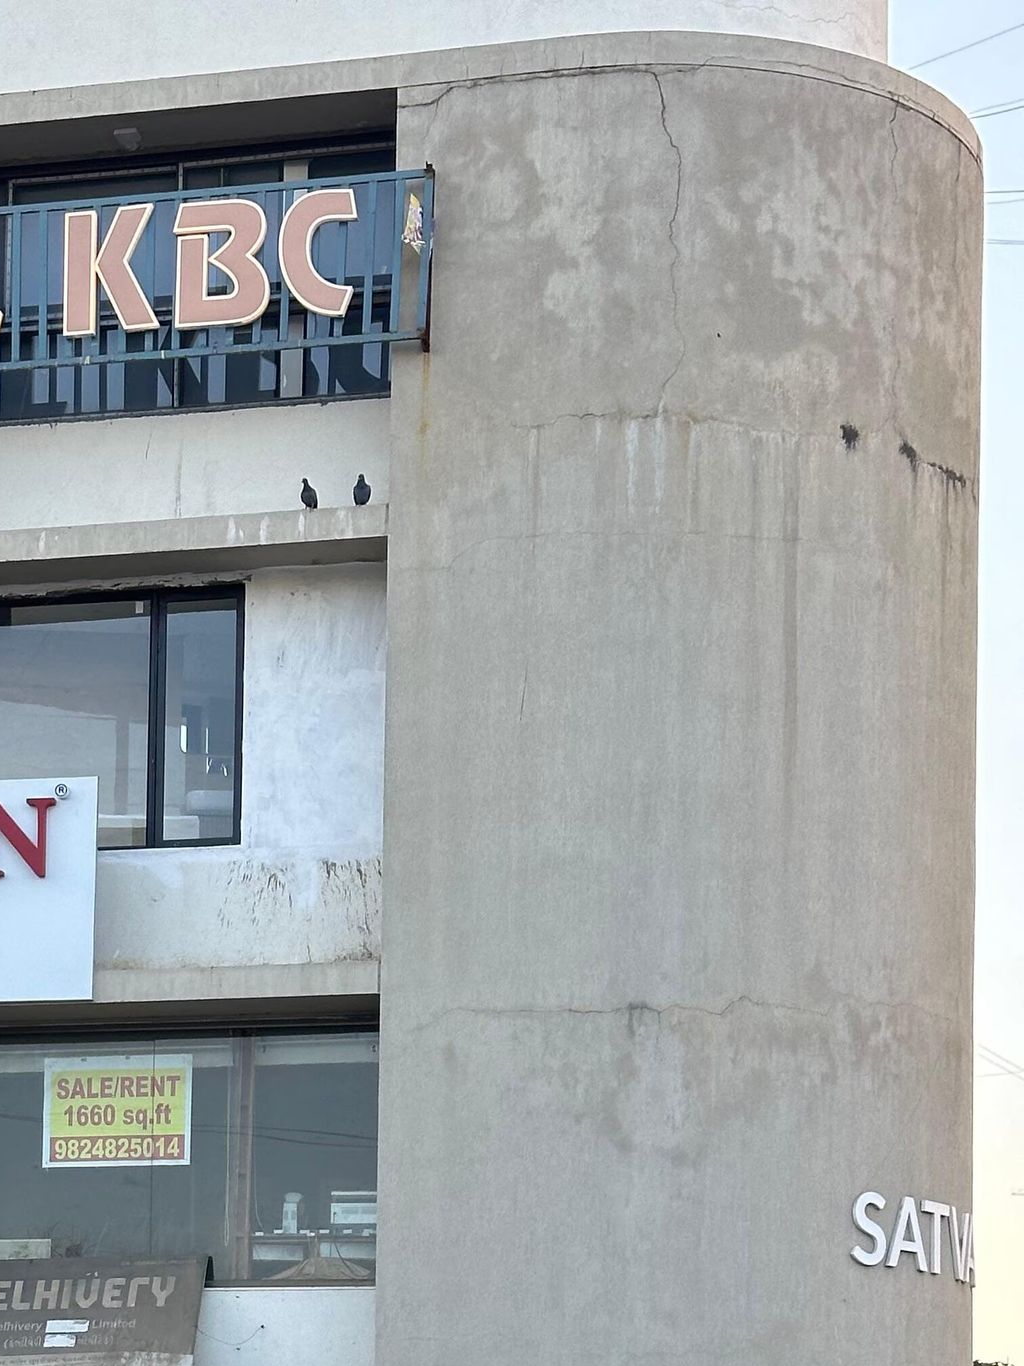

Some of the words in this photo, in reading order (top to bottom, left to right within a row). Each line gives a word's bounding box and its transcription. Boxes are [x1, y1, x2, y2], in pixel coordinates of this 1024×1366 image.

[63, 188, 358, 338] KBC
[56, 1075, 181, 1100] SALE/RENT
[64, 1104, 116, 1127] 1660
[122, 1103, 172, 1130] sq.ft
[54, 1137, 180, 1160] 9824825014
